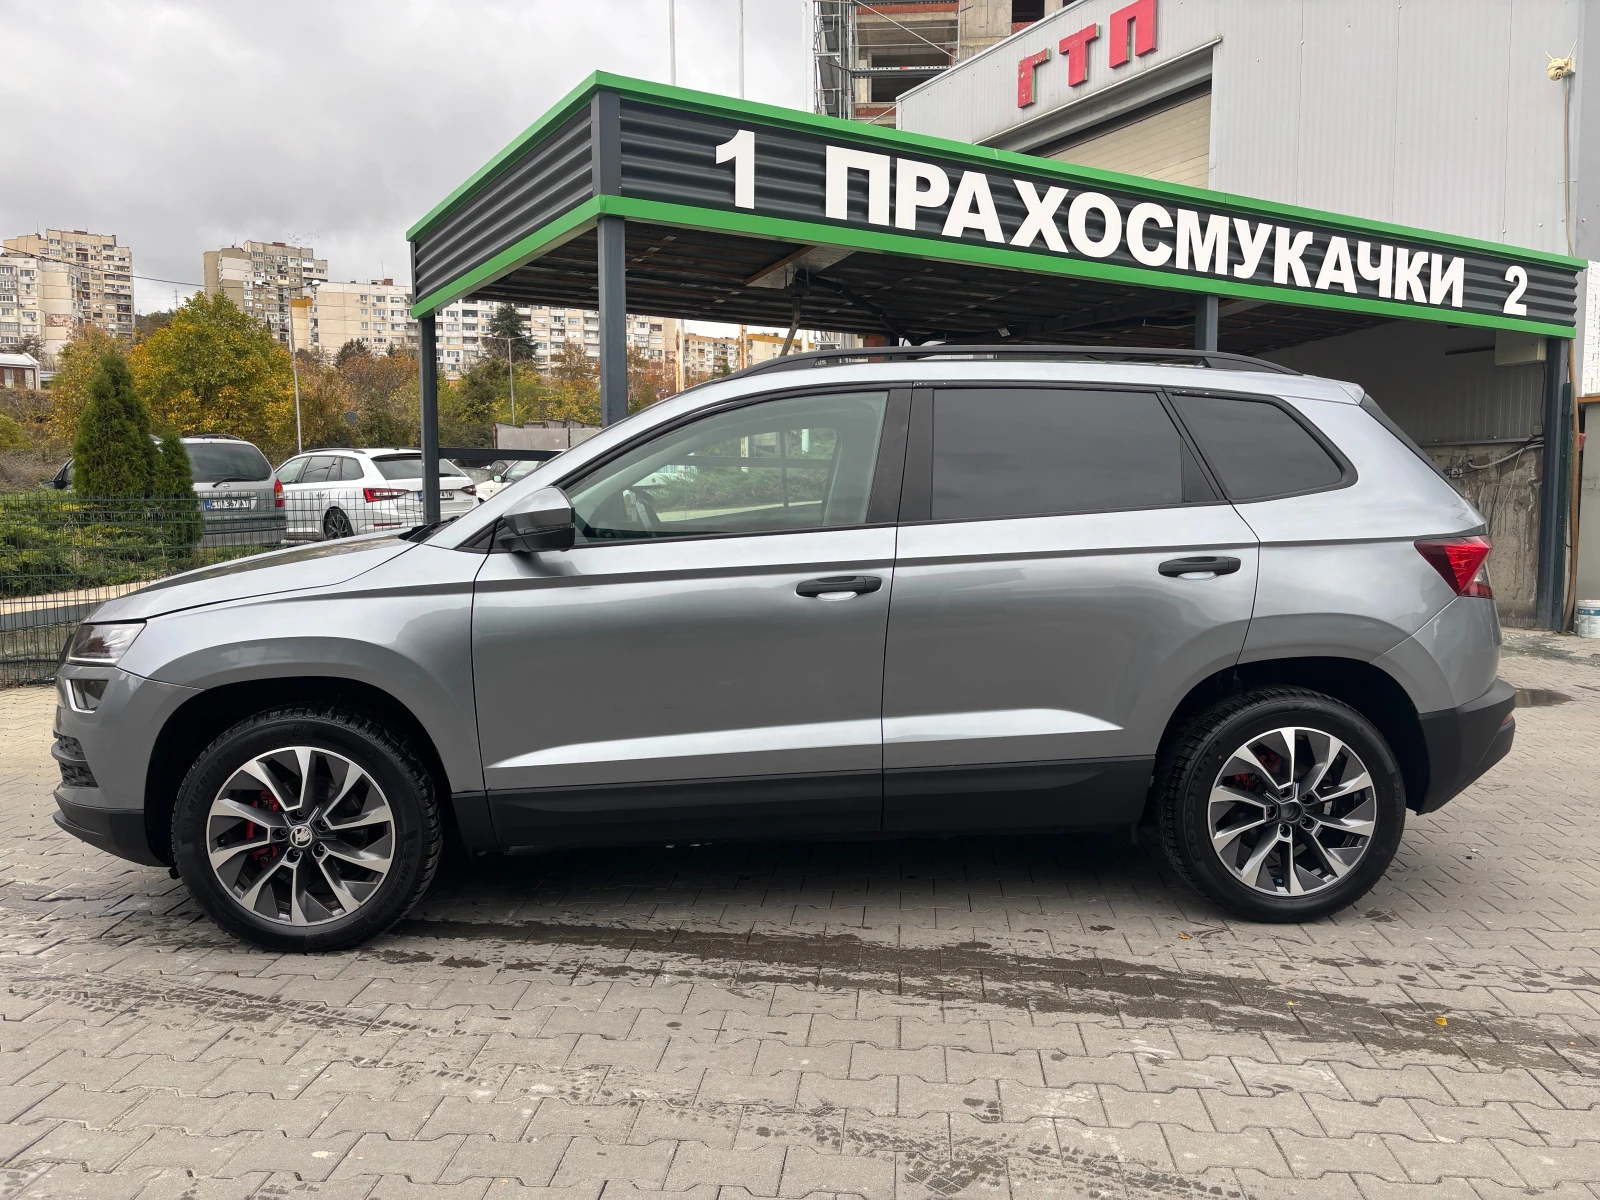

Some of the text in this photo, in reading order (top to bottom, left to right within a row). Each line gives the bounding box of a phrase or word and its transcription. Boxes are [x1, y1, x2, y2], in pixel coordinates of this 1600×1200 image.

[1017, 0, 1158, 108] ГТП
[715, 129, 1528, 316] 1 ПРАХОСМУКАЧКИ 2
